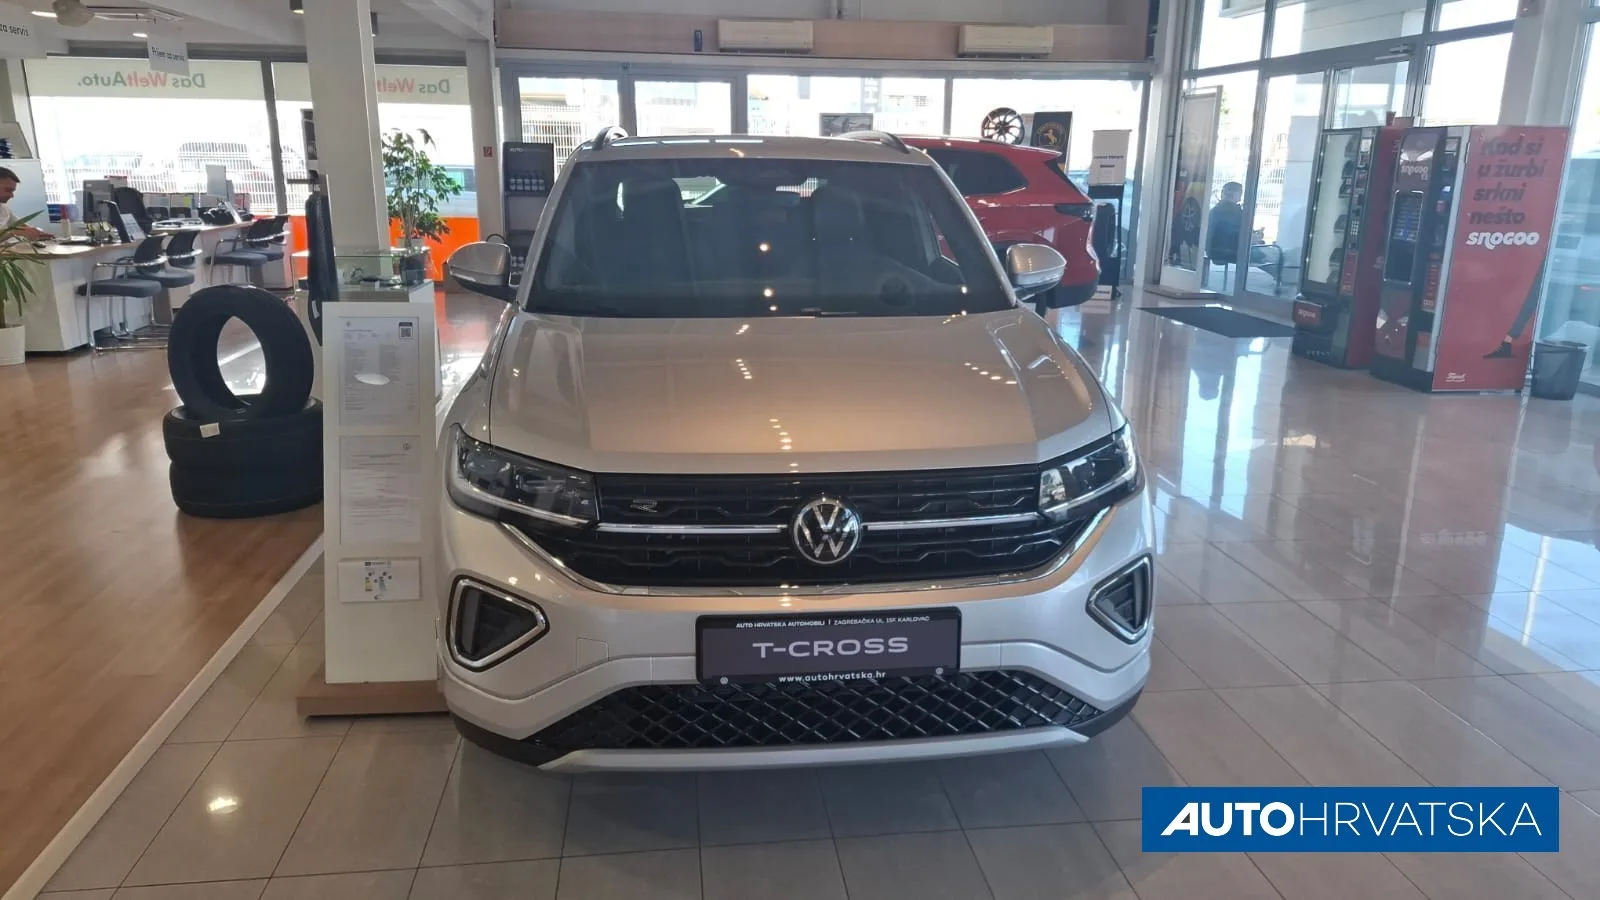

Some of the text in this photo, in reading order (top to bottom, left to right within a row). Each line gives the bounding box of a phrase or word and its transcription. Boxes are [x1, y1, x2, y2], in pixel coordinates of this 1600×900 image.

[9, 25, 29, 37] servis
[1481, 136, 1546, 155] Kod si
[1477, 158, 1548, 178] u žurbi
[1473, 181, 1527, 201] srkni
[1469, 206, 1526, 225] nešto
[898, 615, 931, 623] KARLOVAC
[752, 636, 909, 659] T-CROSS
[778, 670, 886, 683] www.autohrvatska.hr
